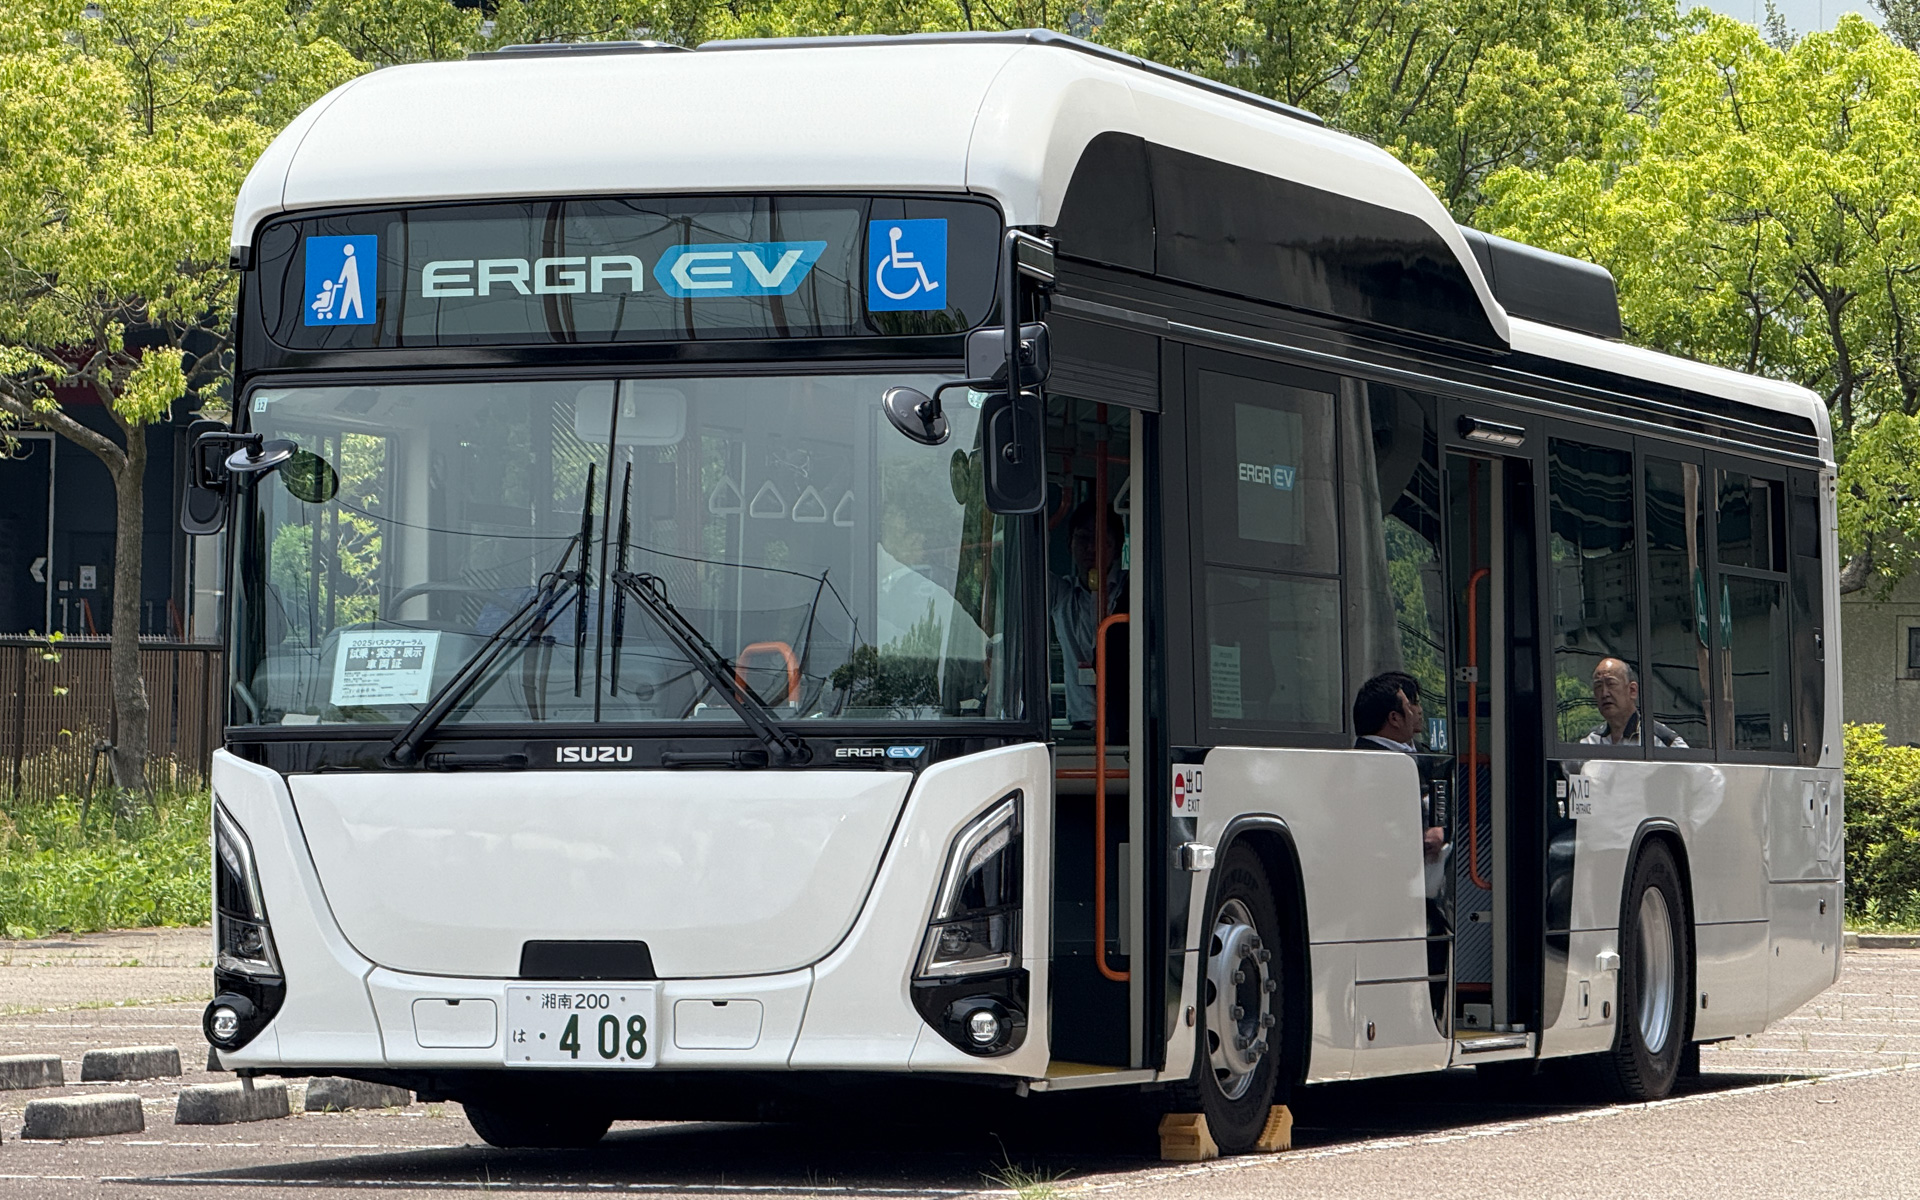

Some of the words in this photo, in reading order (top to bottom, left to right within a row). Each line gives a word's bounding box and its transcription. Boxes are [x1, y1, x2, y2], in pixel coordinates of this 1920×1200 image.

[422, 255, 644, 297] ERGA
[671, 249, 804, 288] EV
[1239, 463, 1271, 484] ERGA
[1274, 468, 1293, 487] EV
[352, 639, 423, 647] 2025バステクフォーラム
[366, 659, 402, 669] 車両証
[556, 746, 633, 763] ISUZU
[835, 747, 885, 758] ERGA
[890, 747, 920, 757] EV
[1186, 769, 1202, 793] 出口
[1578, 779, 1589, 798] 入口
[1187, 798, 1200, 812] EXIT
[541, 993, 610, 1009] 湘南200
[512, 1028, 526, 1043] は
